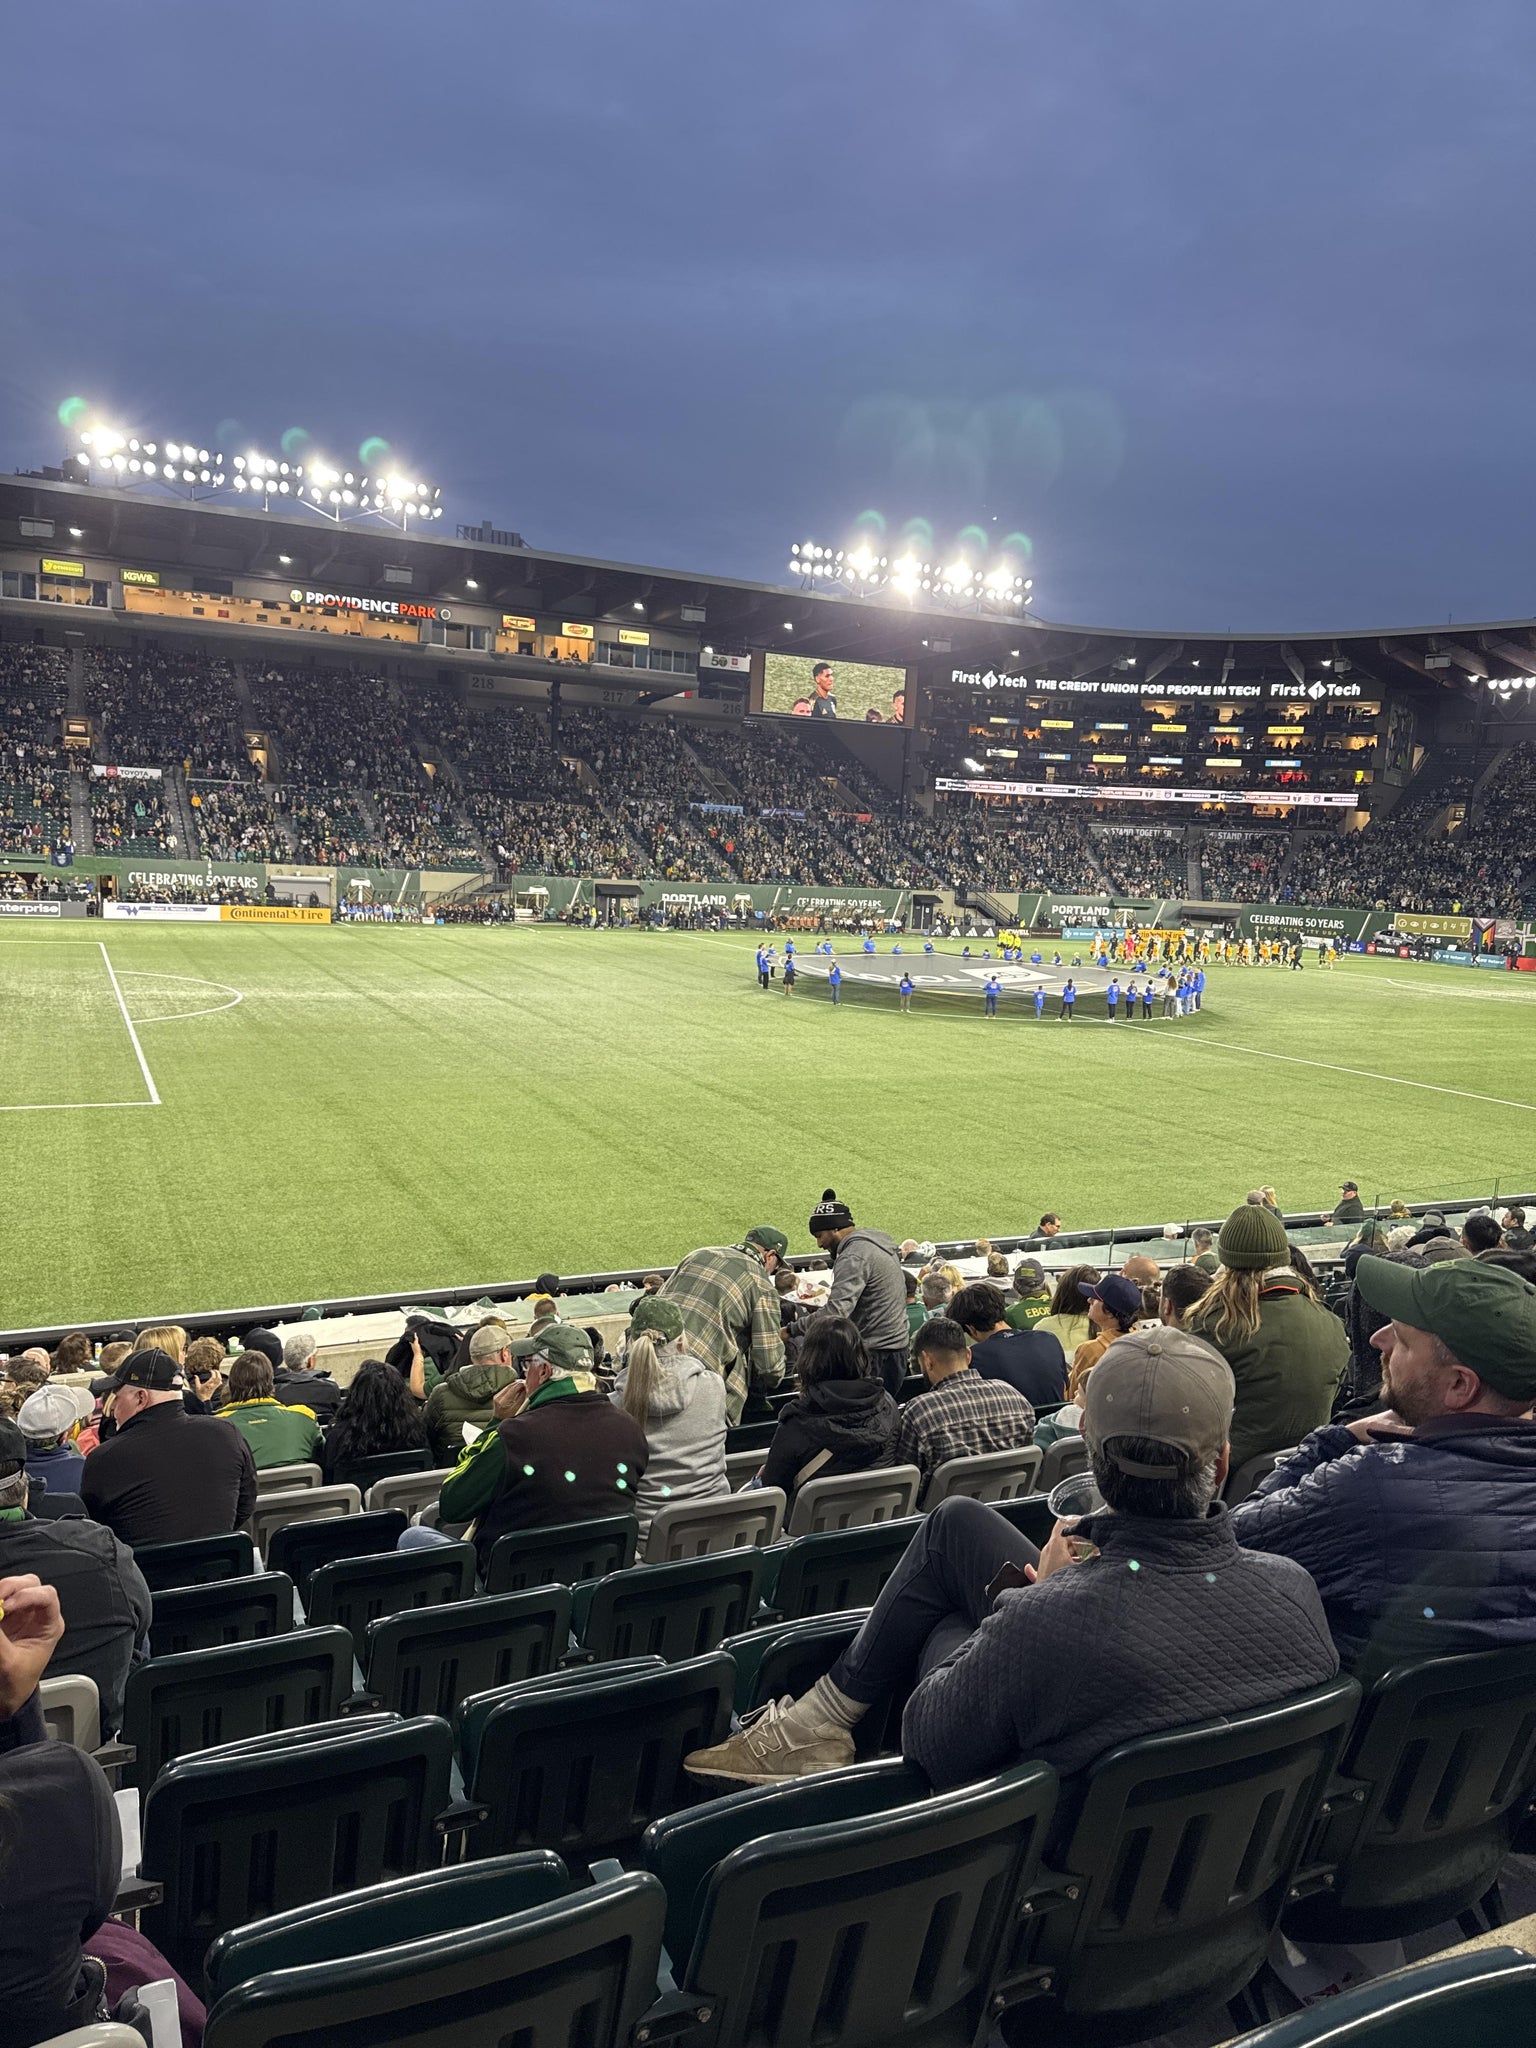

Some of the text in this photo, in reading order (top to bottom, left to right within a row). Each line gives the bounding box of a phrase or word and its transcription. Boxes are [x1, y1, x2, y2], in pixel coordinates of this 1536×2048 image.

[471, 676, 495, 690] 218
[951, 670, 1028, 688] First Tech
[1035, 679, 1261, 696] THE CREDIT UNION FOR PEOPLE IN TECH
[1270, 684, 1361, 696] First Tech
[602, 690, 624, 703] 217
[722, 703, 742, 714] 216
[120, 769, 149, 777] TOYOTA
[1136, 829, 1172, 837] TOGETER
[128, 872, 204, 886] CELEBRATING
[223, 876, 258, 888] YEARS
[661, 893, 727, 905] PORTLAND
[0, 903, 58, 914] nterprise
[230, 908, 323, 919] Continental Tire
[1052, 905, 1110, 916] PORTLAND
[1250, 914, 1344, 929] CELEBRATING 50 YEARS
[1376, 947, 1396, 955] TOYOTA
[1409, 950, 1430, 958] TOA
